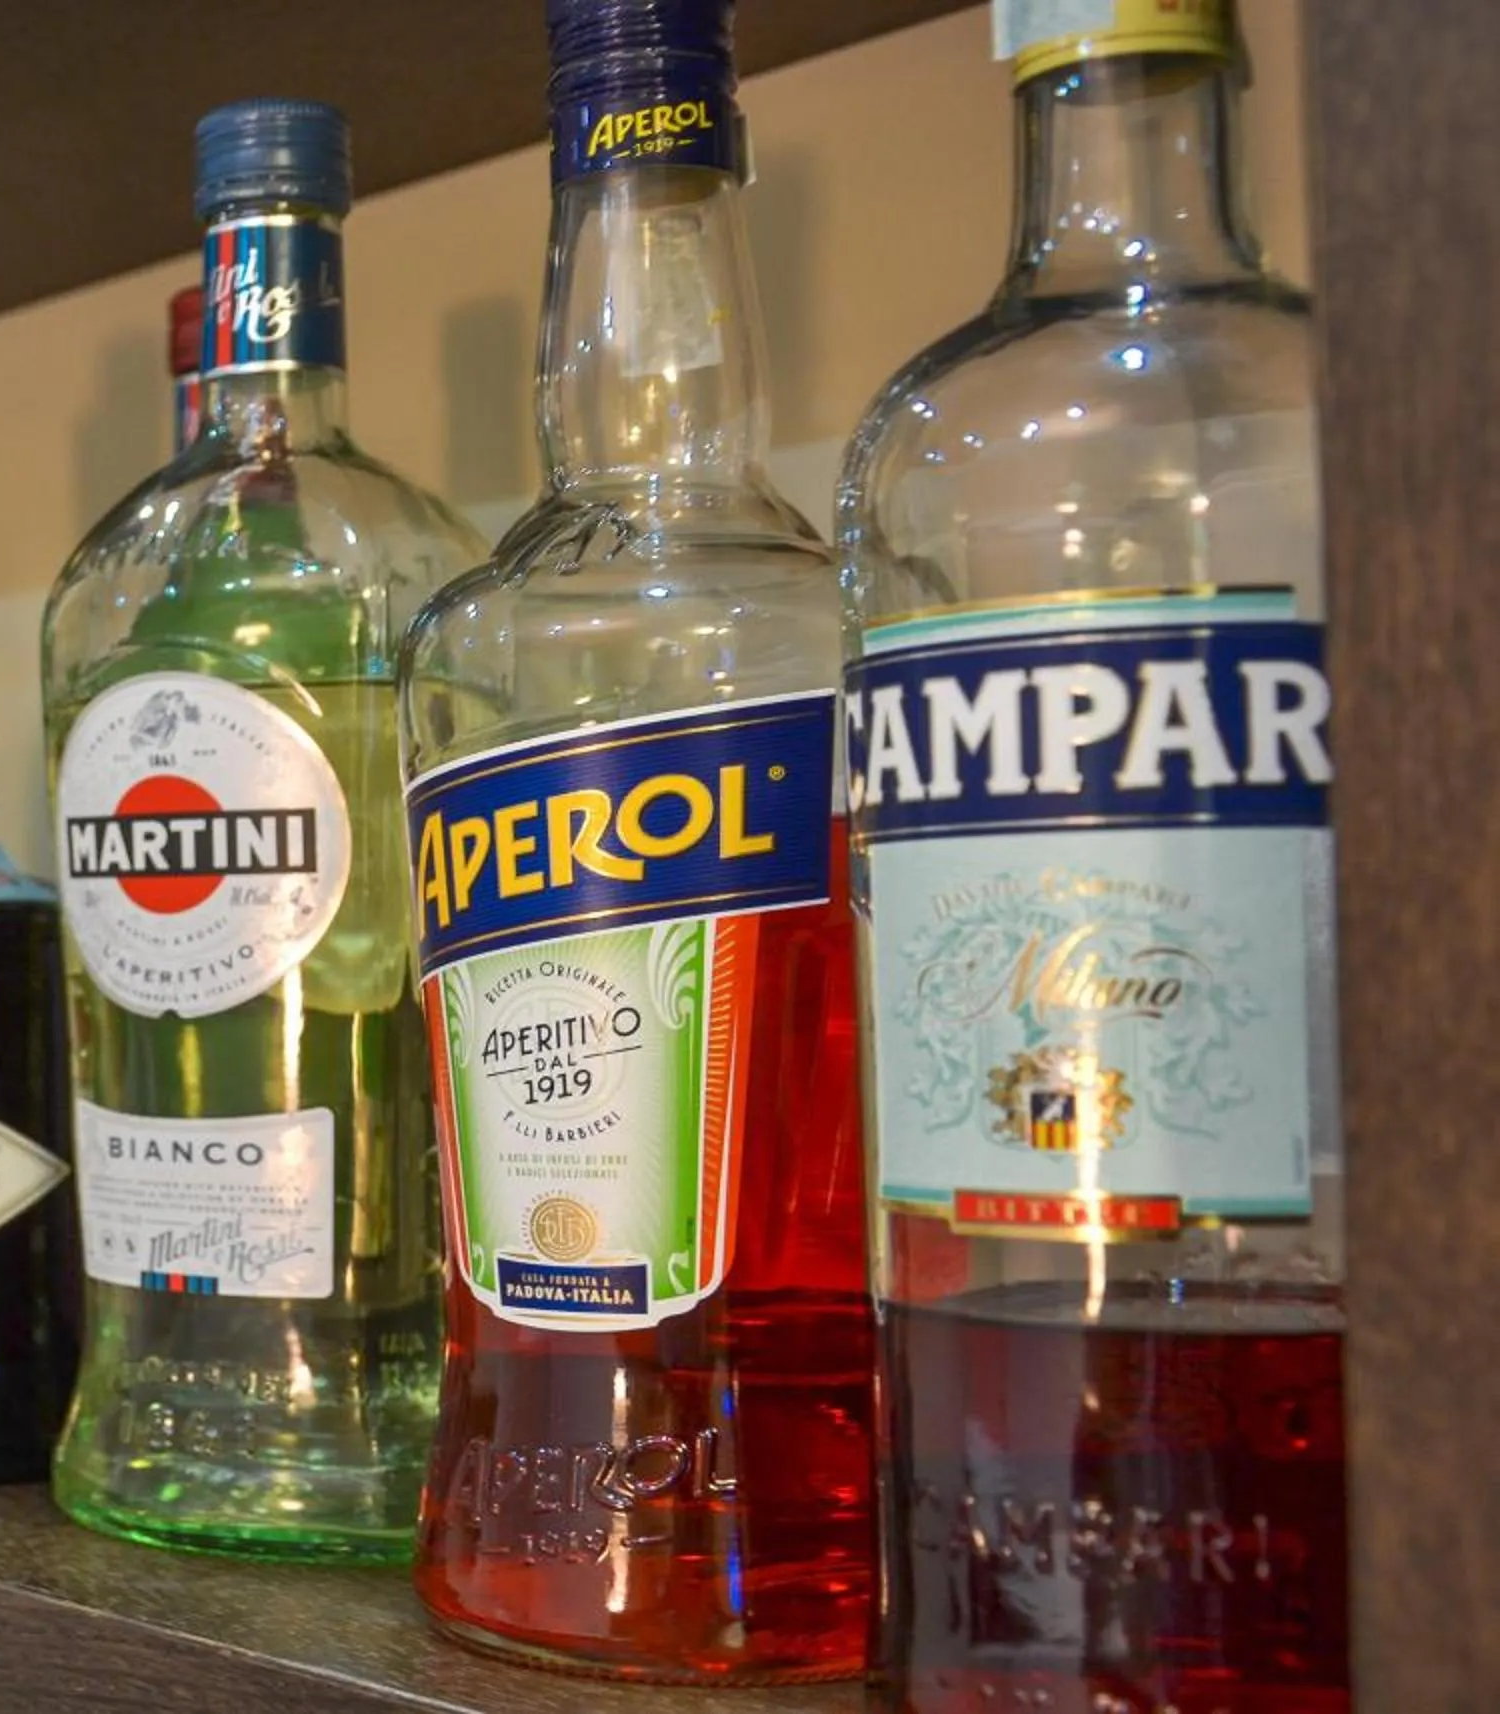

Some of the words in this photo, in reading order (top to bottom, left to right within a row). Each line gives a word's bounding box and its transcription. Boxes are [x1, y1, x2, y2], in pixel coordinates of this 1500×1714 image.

[586, 101, 713, 157] APEROL
[633, 137, 676, 157] 1919
[70, 815, 306, 873] MARTINI
[417, 764, 776, 942] APEROL
[484, 967, 533, 1005] RICETTA
[539, 961, 627, 1003] ORIGINALE
[481, 1007, 641, 1064] APERITIVO
[534, 1053, 578, 1073] DAL
[523, 1069, 592, 1105] 1919
[545, 1111, 621, 1143] BARBIERI
[108, 1137, 264, 1166] BIANCO
[505, 1283, 636, 1306] PADOVA-ITALIA
